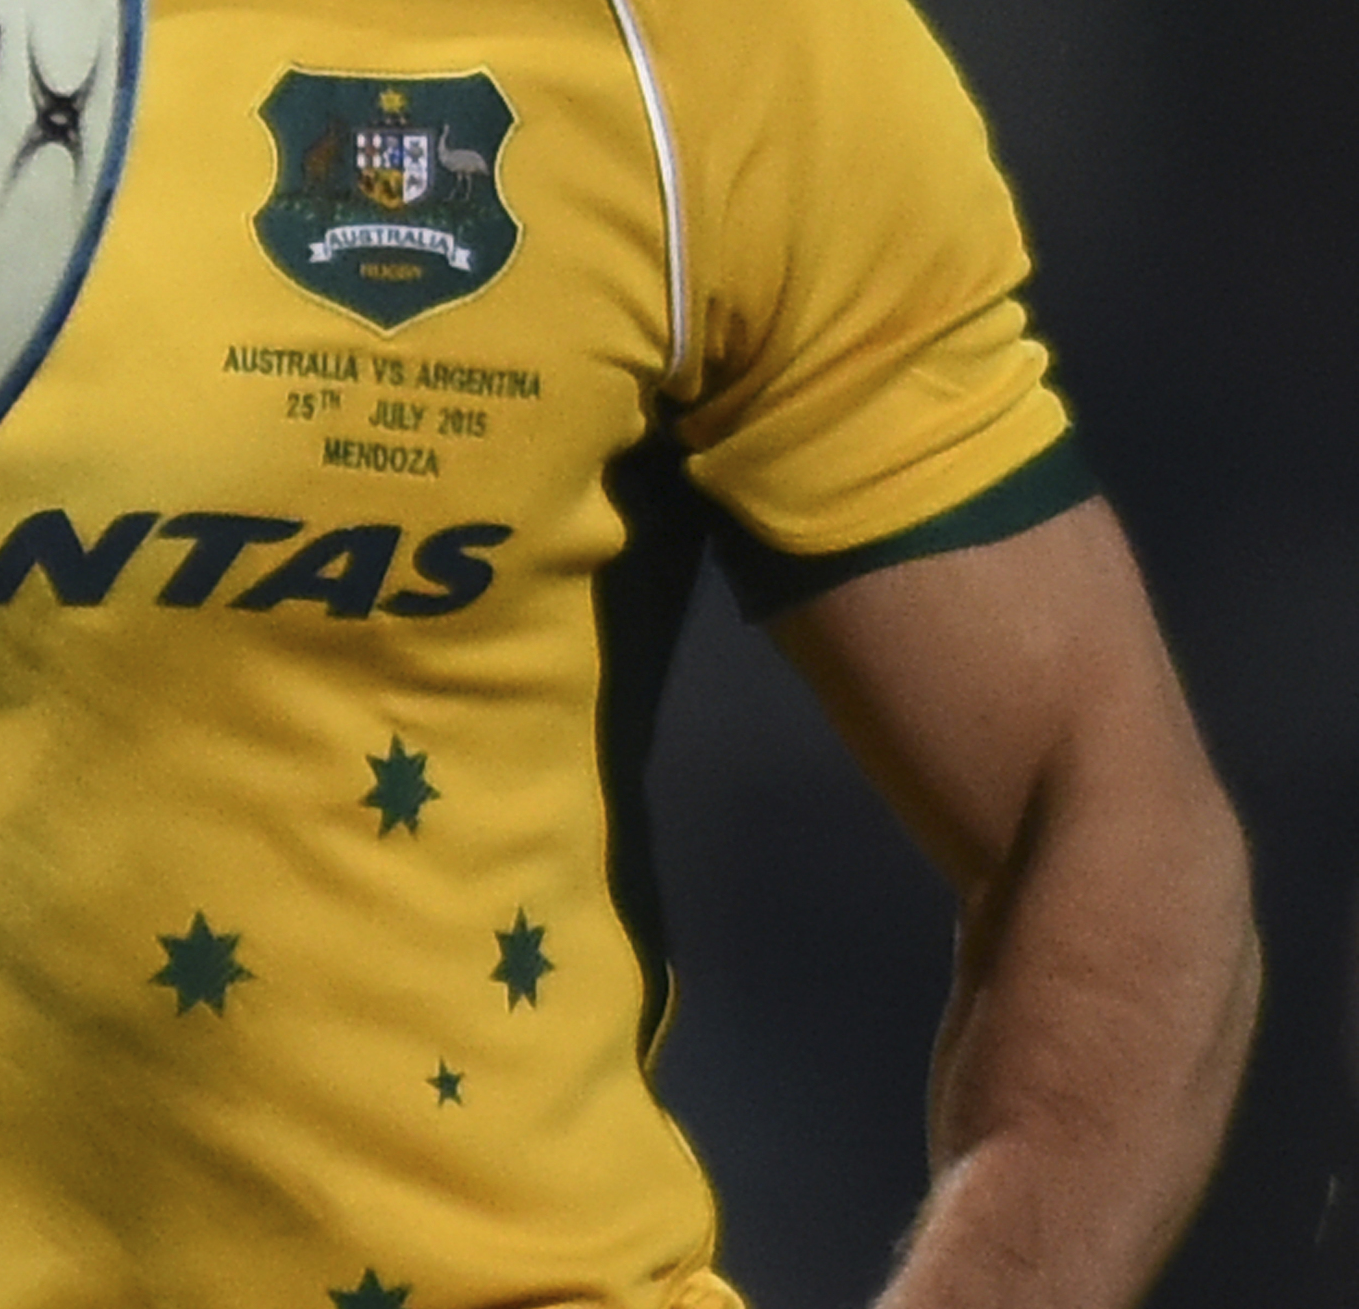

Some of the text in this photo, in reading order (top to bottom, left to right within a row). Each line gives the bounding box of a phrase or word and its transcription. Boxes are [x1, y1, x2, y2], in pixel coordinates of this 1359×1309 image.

[328, 227, 450, 253] AUSTRALIA
[223, 345, 542, 399] AUSTRALIA VS ARGENTINA
[369, 398, 426, 432] JULY
[437, 405, 488, 436] 2015
[322, 438, 440, 477] MENDOZA
